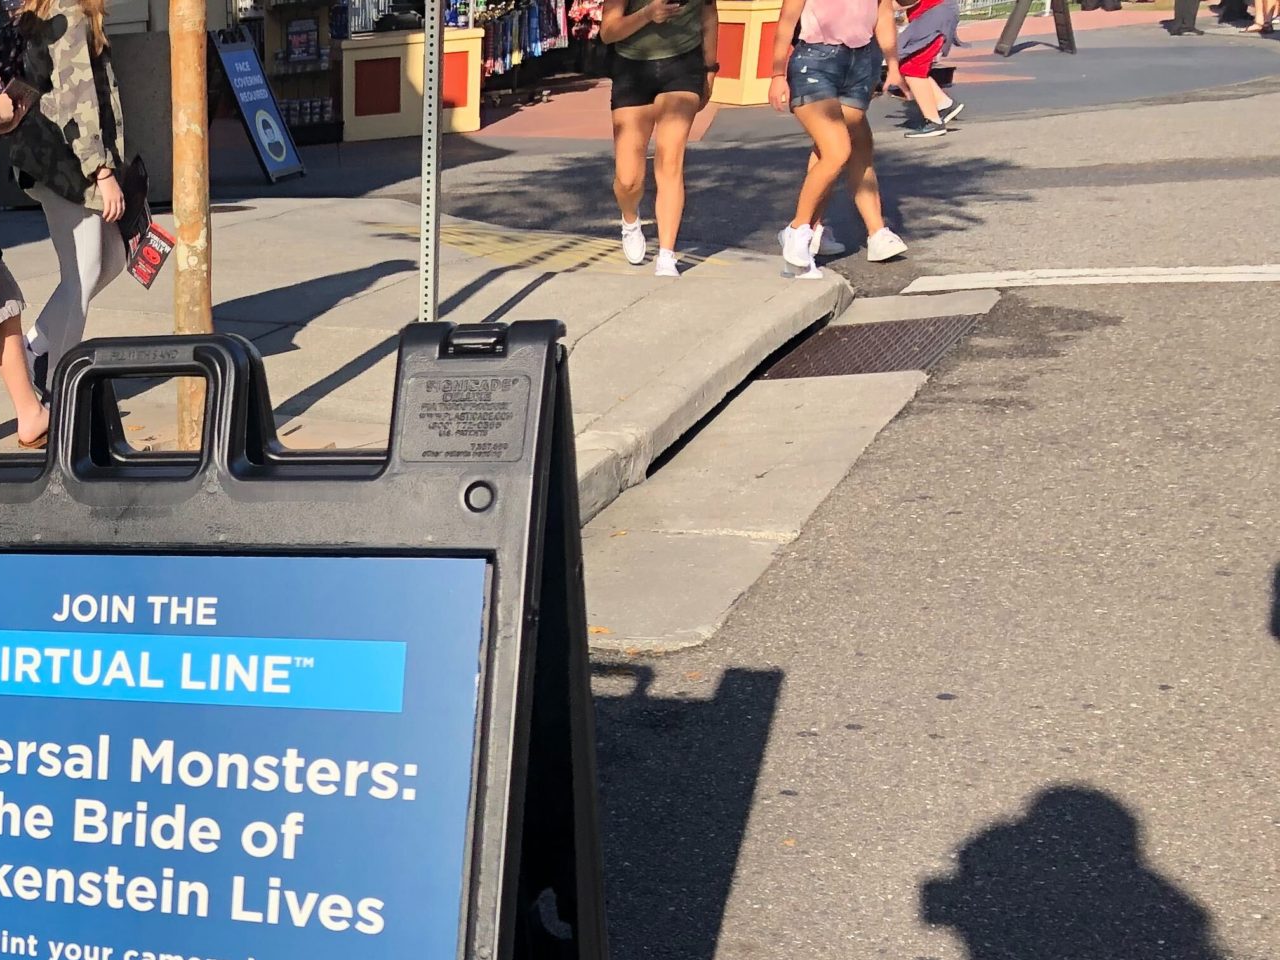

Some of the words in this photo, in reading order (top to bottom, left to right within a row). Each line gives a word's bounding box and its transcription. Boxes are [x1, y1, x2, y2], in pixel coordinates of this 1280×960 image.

[233, 75, 263, 88] COVERING
[234, 61, 251, 72] FACE
[240, 89, 268, 102] REQUIRED
[52, 594, 135, 624] JOIN
[147, 595, 218, 626] THE
[130, 738, 419, 801] Monsters:
[73, 798, 221, 853] Bride
[241, 812, 305, 861] of
[231, 875, 386, 936] Lives
